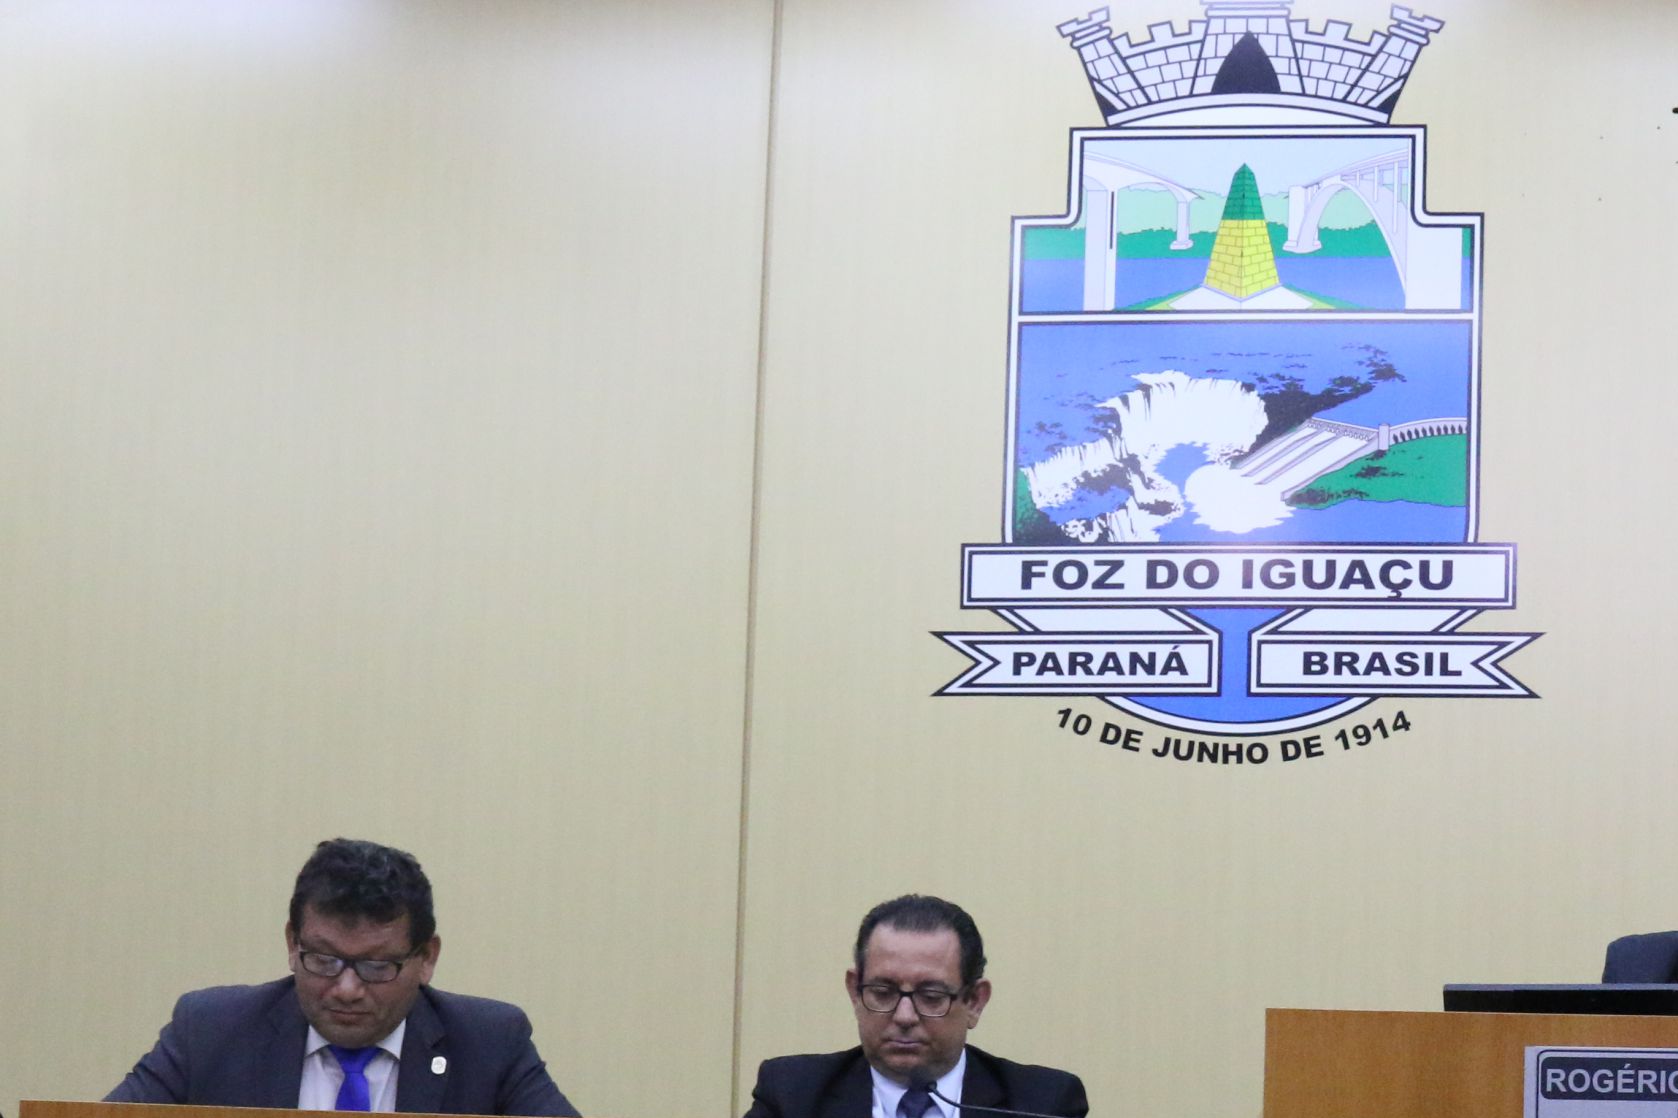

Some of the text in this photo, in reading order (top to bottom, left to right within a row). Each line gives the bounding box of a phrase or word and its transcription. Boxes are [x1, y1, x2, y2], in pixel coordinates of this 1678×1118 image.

[1020, 559, 1455, 599] FOZ DO IGUAÇU
[1011, 645, 1189, 676] PARANÁ
[1302, 652, 1463, 677] BRASIL
[1055, 707, 1413, 765] 10 DE JUNHO DE 1914
